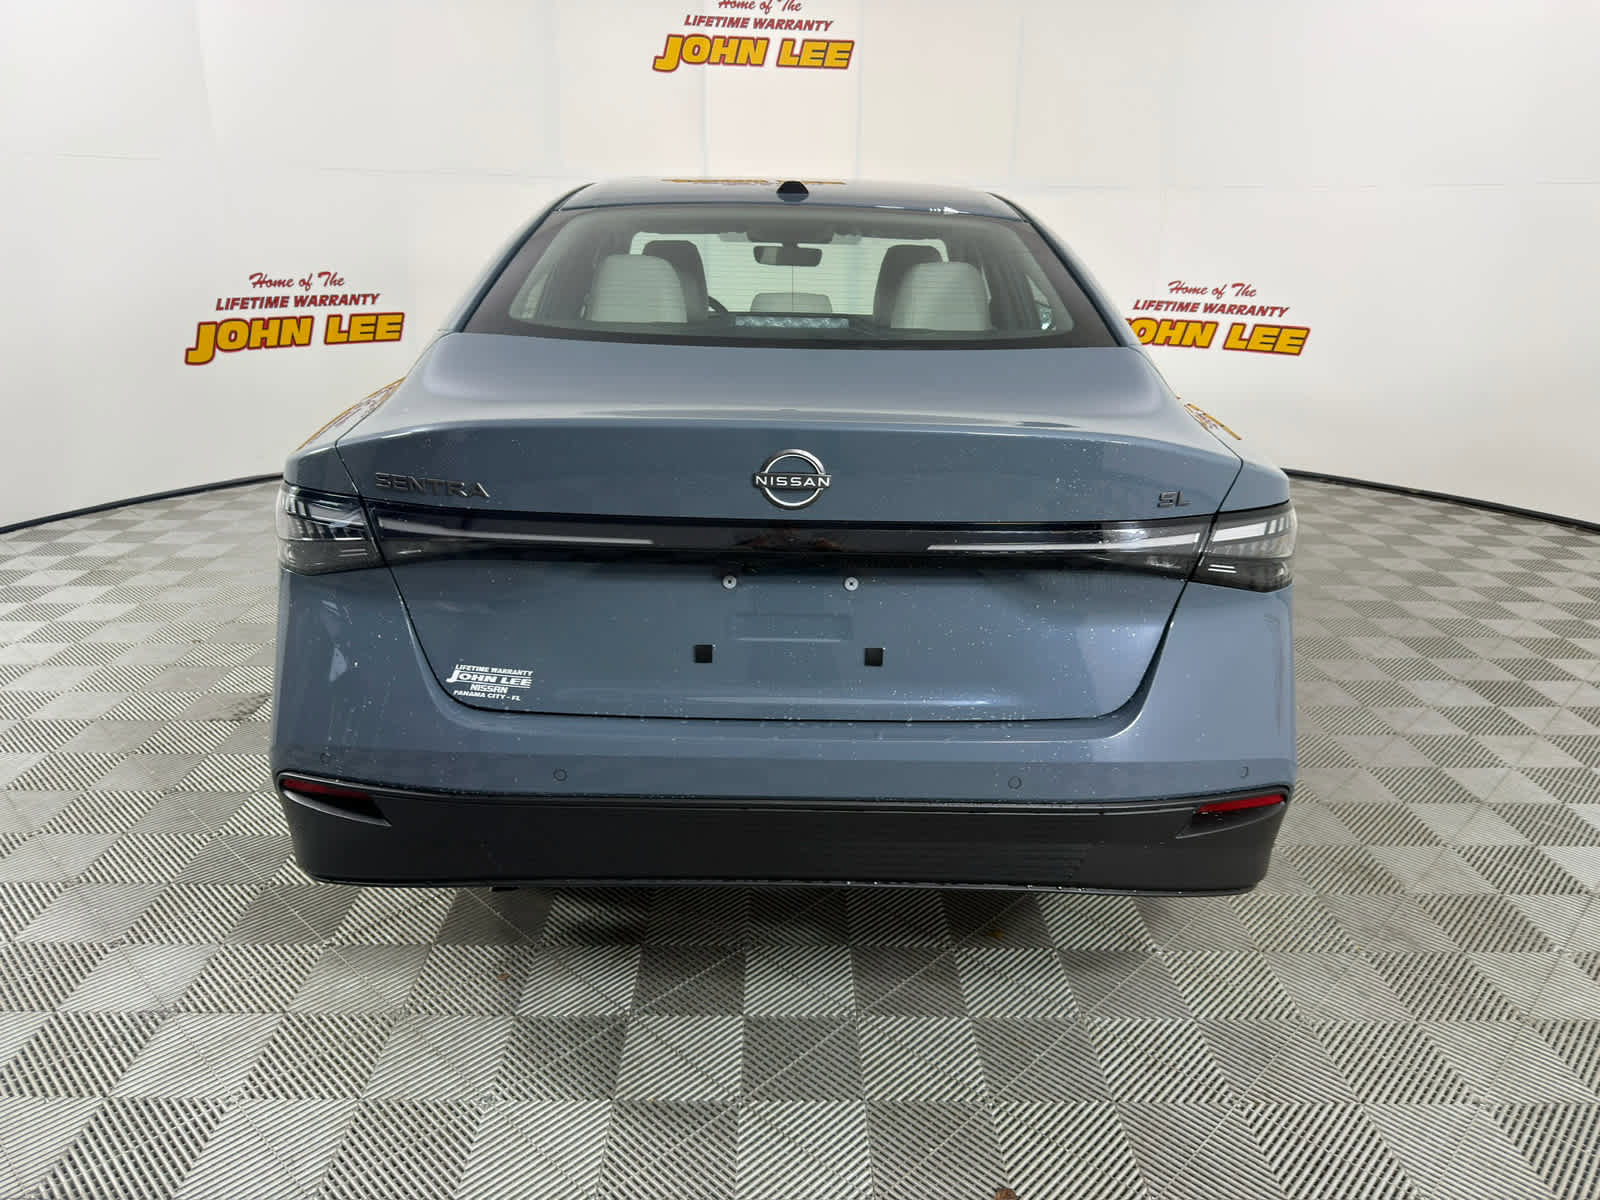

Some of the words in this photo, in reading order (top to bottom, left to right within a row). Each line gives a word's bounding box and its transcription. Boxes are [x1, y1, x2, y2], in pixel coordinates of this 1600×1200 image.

[759, 0, 773, 15] of
[684, 15, 750, 29] LIFETIME
[752, 18, 834, 32] WARRANTY
[652, 34, 769, 73] JOHN
[776, 39, 855, 69] LEE
[249, 272, 294, 289] Home
[298, 272, 312, 291] of
[317, 271, 345, 287] The
[1168, 280, 1209, 295] Home
[1211, 284, 1228, 300] of
[1231, 283, 1257, 298] The
[215, 296, 290, 311] LIFETIME
[293, 293, 380, 308] WARRANTY
[1133, 299, 1201, 314] LIFETIME
[1202, 302, 1290, 318] WARRANTY
[185, 315, 314, 365] JOHN
[324, 312, 405, 344] LEE
[1125, 317, 1219, 349] OHN
[1222, 322, 1311, 356] LEE
[375, 472, 491, 498] SENTRA
[755, 475, 831, 487] NISSAN
[1157, 490, 1192, 508] SL
[446, 669, 498, 683] JOHN
[500, 677, 532, 687] LEE
[455, 664, 490, 673] LIFETIME
[490, 667, 534, 676] WARRANTY
[453, 690, 486, 698] PANAMA
[470, 684, 509, 693] NISSAN
